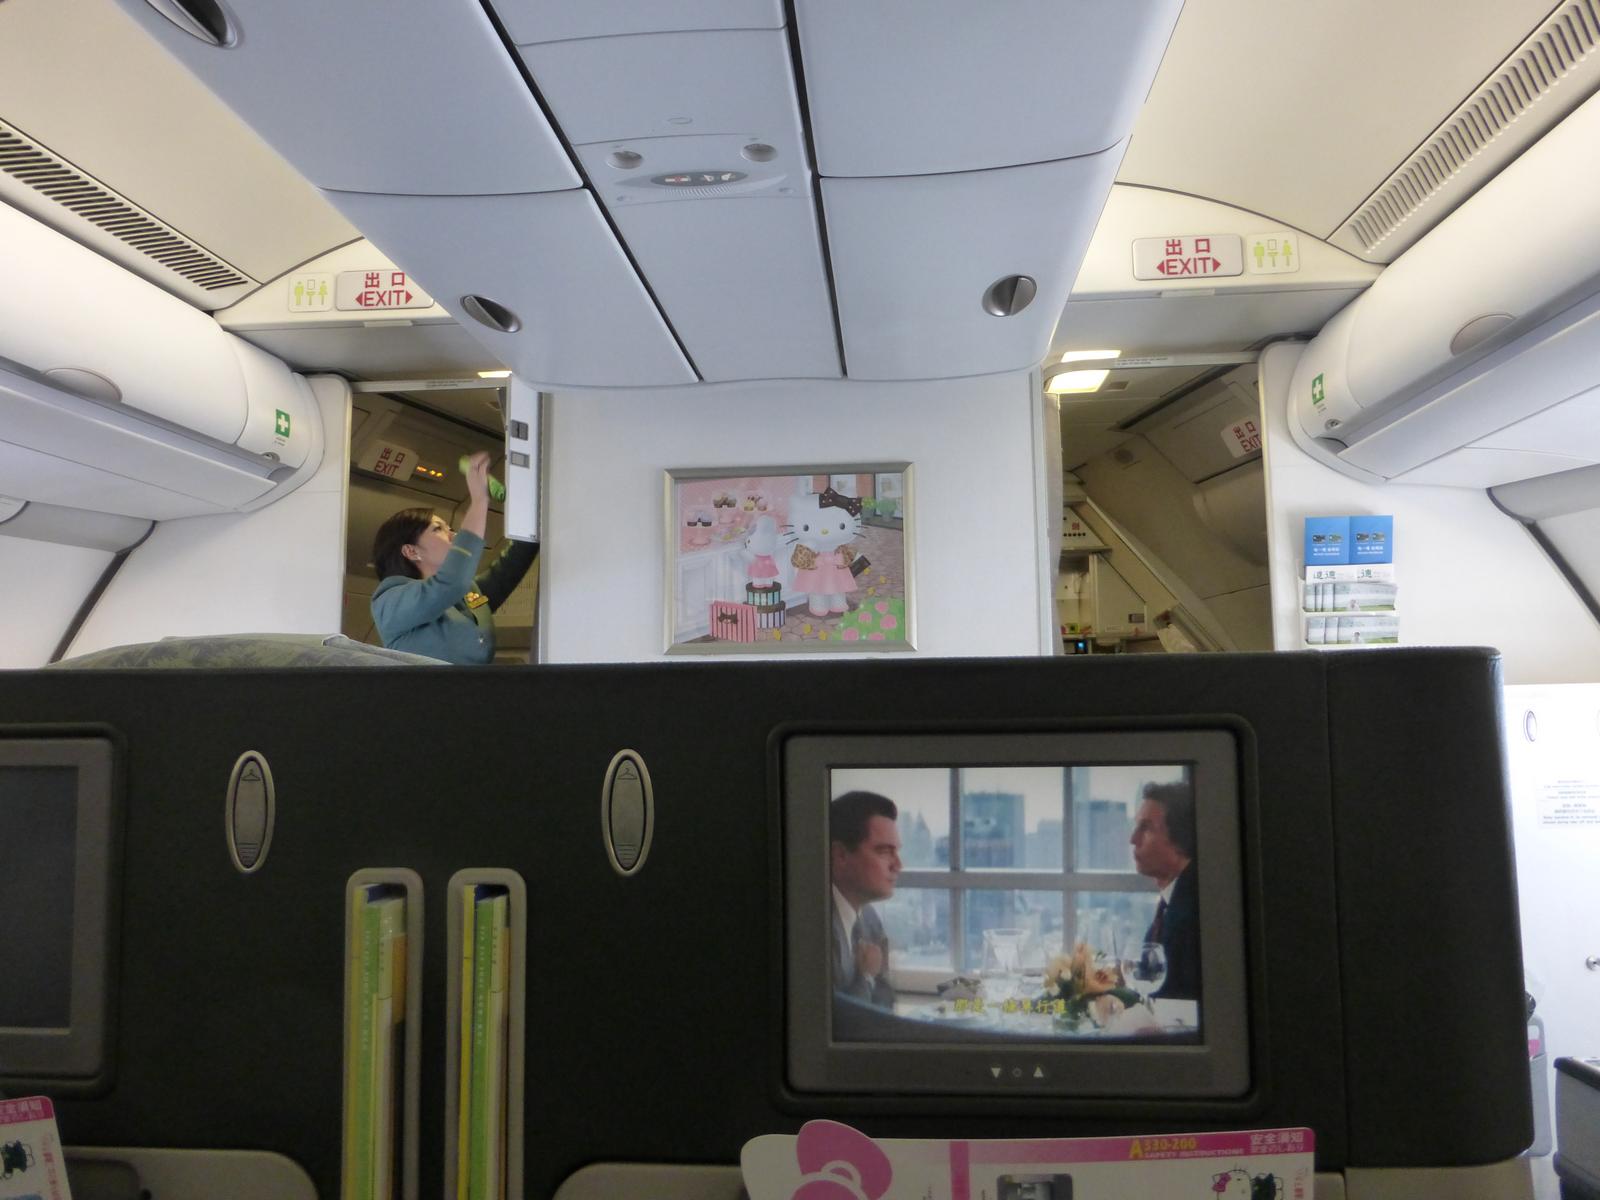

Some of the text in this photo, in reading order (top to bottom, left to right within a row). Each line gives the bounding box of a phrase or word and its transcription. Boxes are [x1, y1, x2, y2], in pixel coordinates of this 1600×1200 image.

[1165, 238, 1211, 256] 出口
[1166, 256, 1211, 275] EXIT
[364, 272, 406, 289] 出口
[363, 290, 405, 307] EXIT
[1232, 421, 1256, 439] 出口
[380, 447, 406, 464] 出口
[374, 459, 400, 476] EXIT
